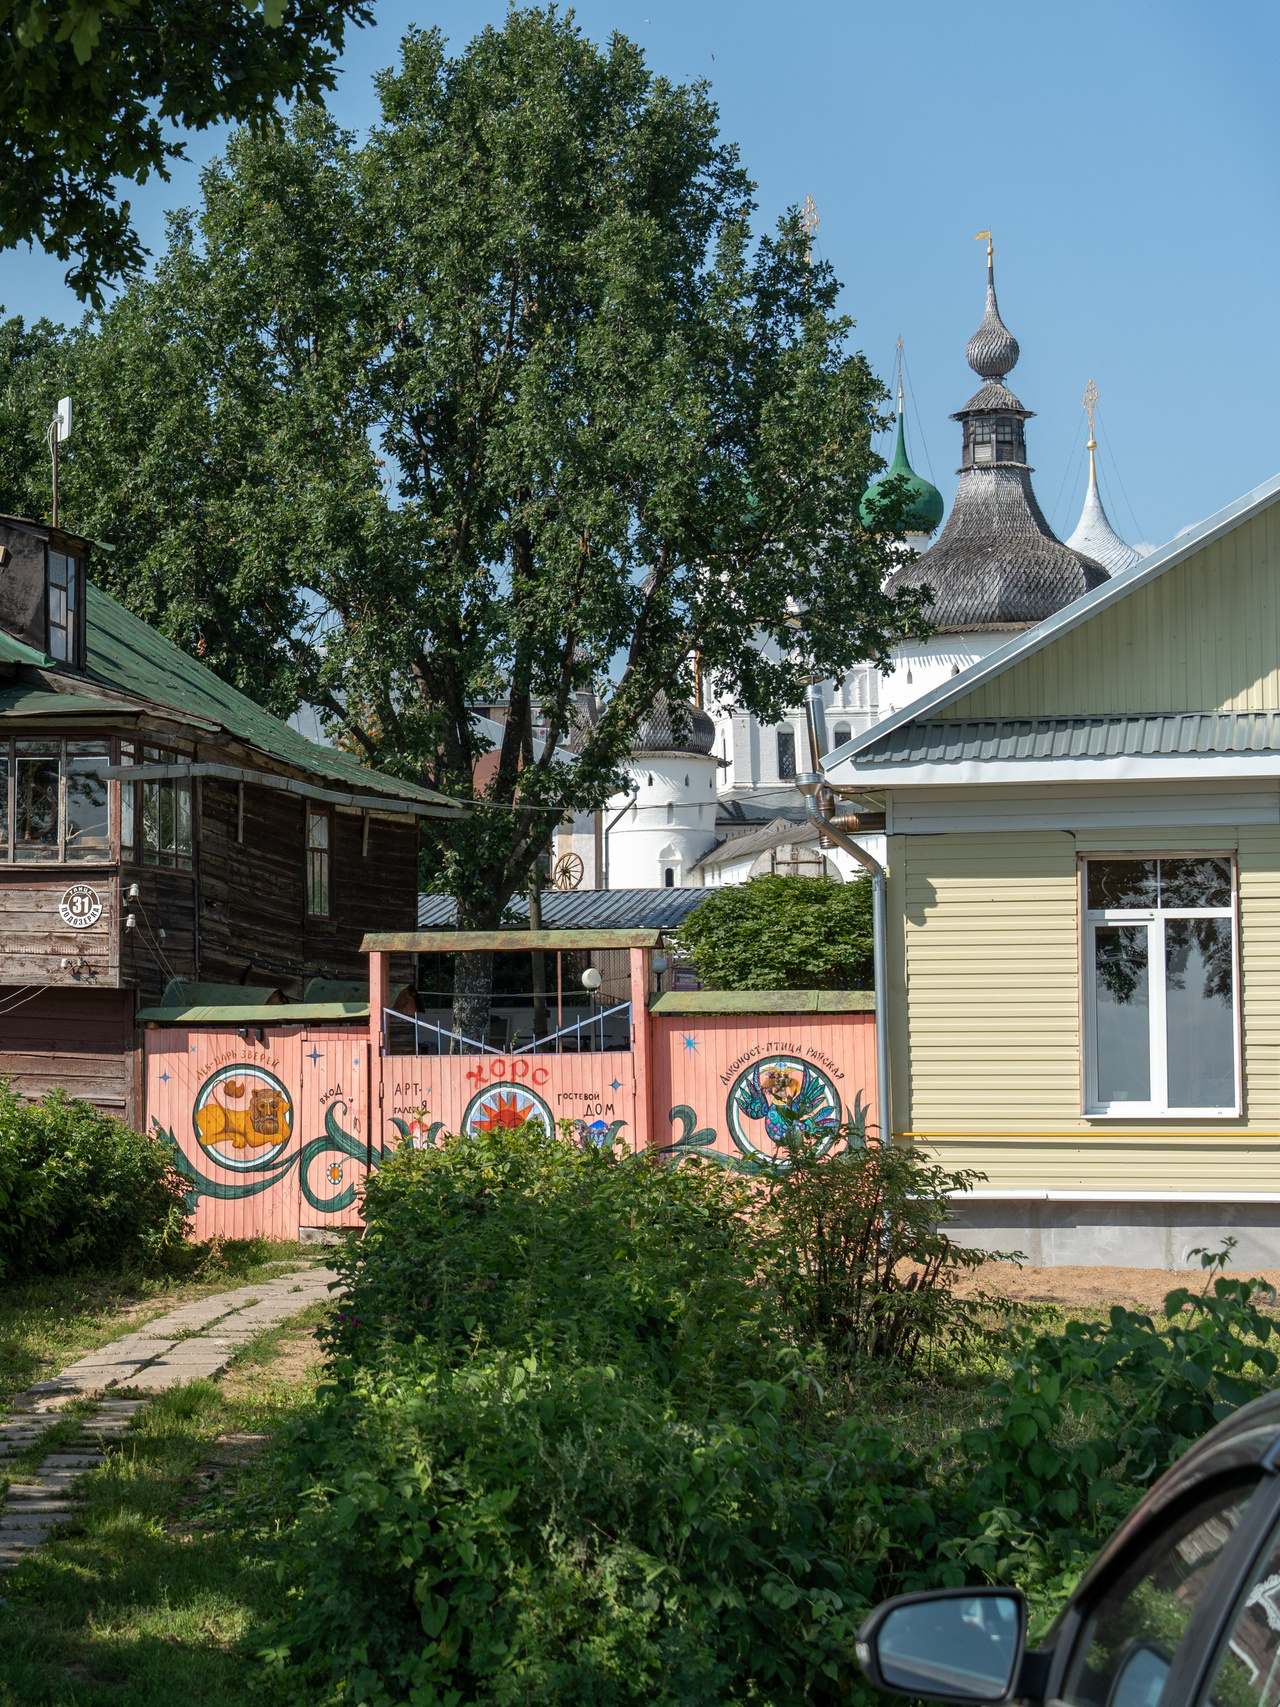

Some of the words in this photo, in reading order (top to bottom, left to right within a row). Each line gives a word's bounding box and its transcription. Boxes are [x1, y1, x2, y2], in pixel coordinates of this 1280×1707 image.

[69, 887, 92, 895] УЛИЦА
[72, 896, 89, 914] 31
[61, 907, 100, 925] ПОДОЗЕРКА
[240, 1049, 280, 1069] ЗВЕРЕЙ
[319, 1083, 343, 1105] ВХОД
[394, 1082, 422, 1096] АРТ-
[557, 1091, 600, 1105] ГОСТЕВОЙ
[583, 1103, 615, 1117] ДОМ
